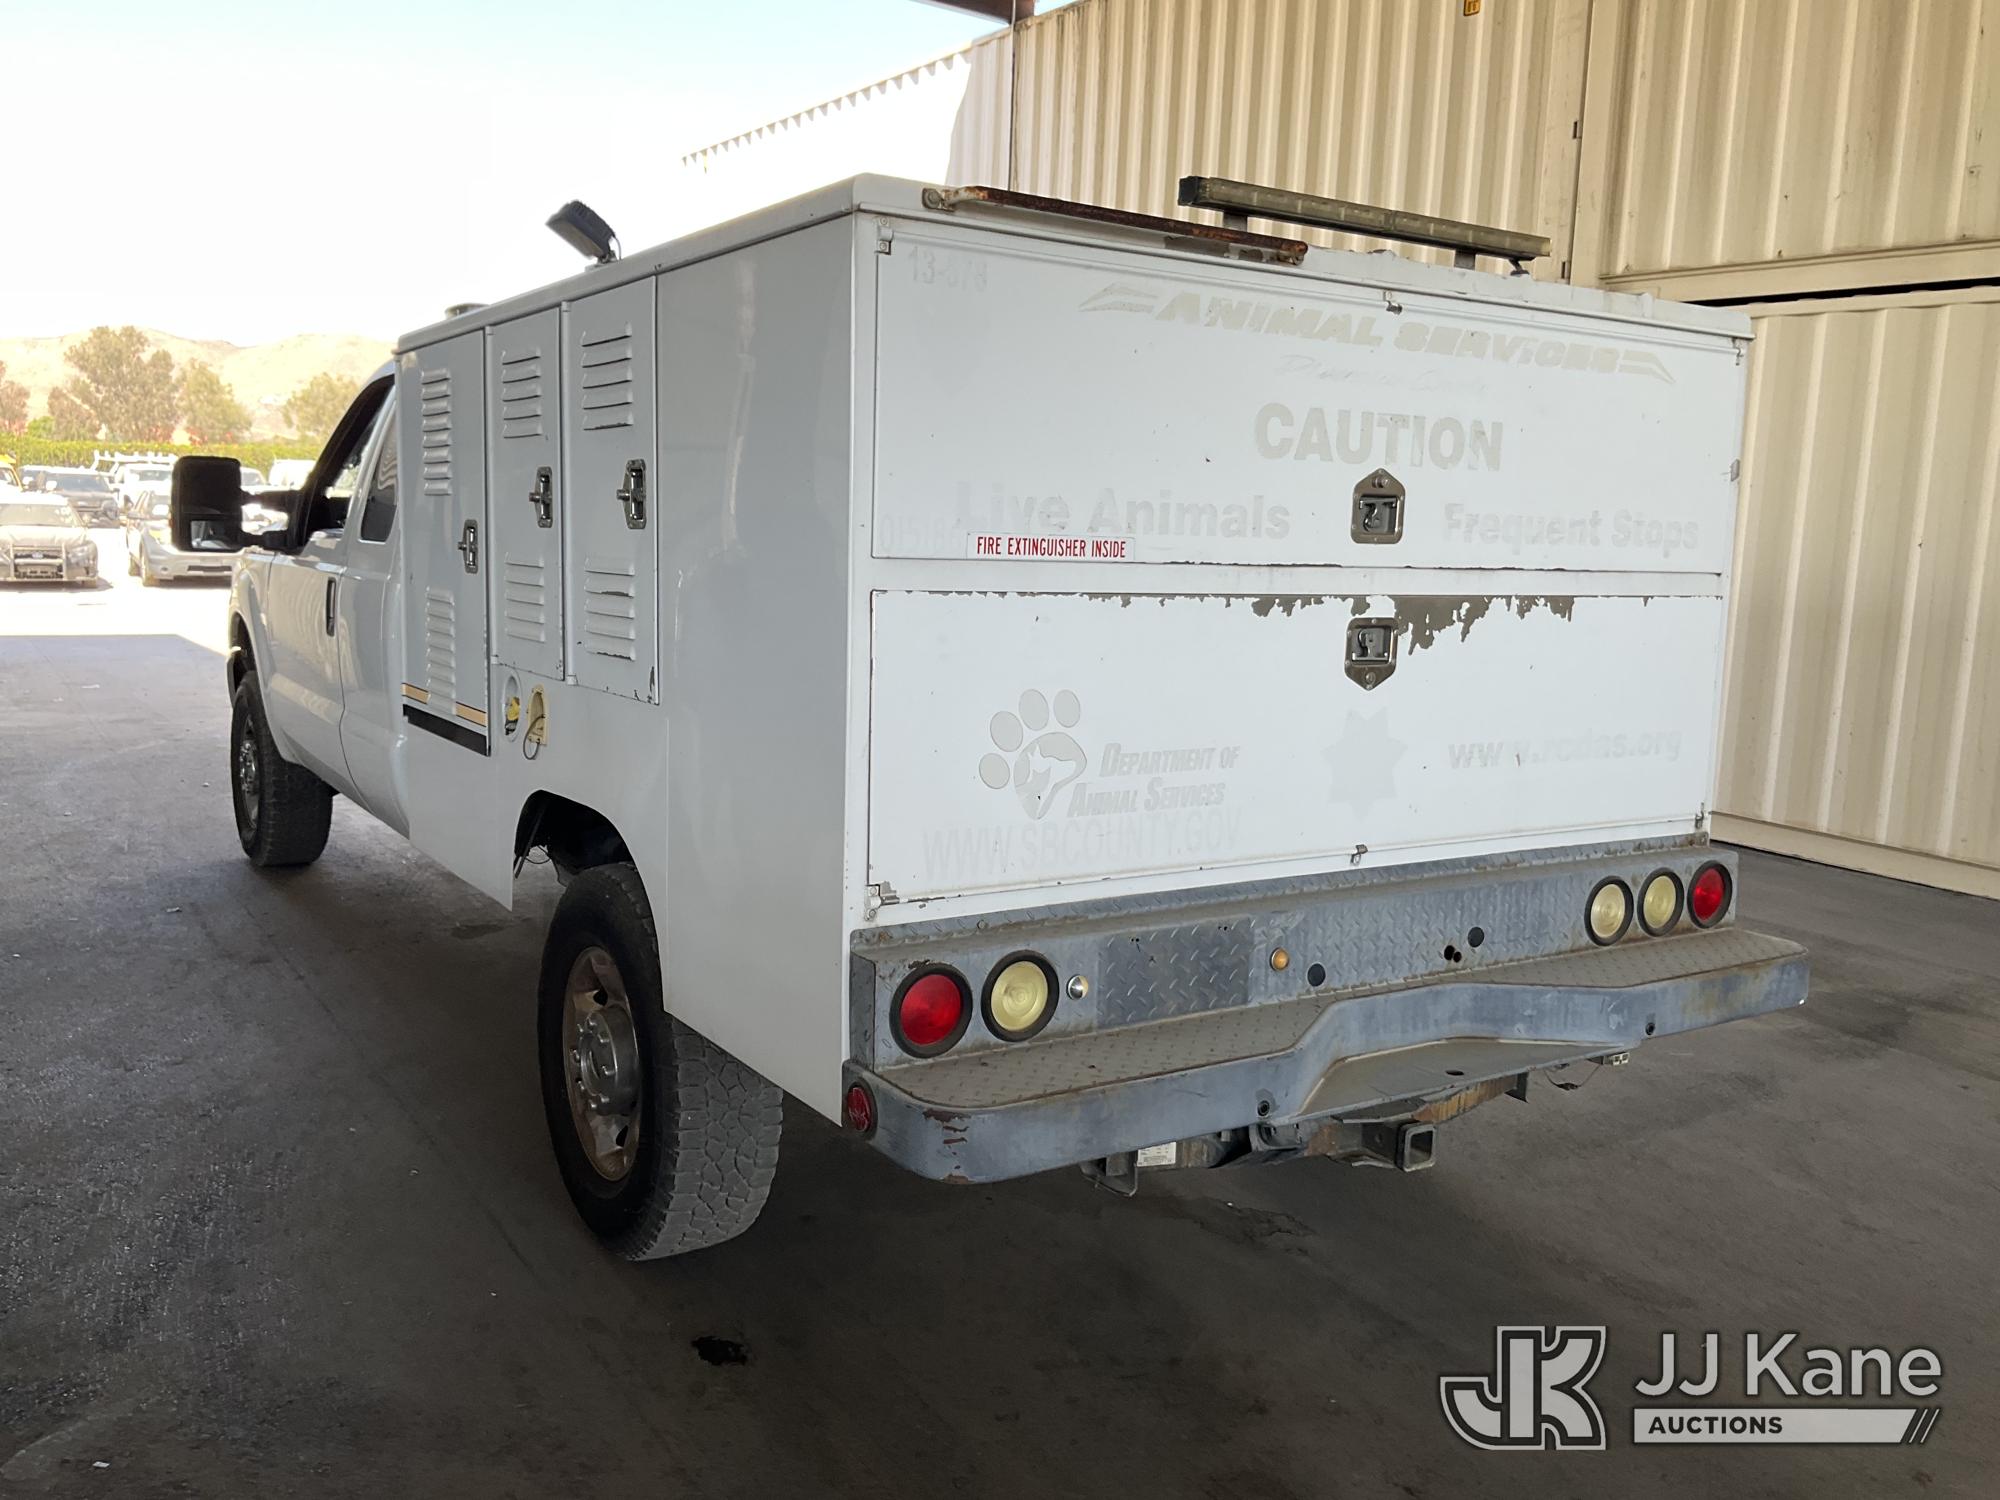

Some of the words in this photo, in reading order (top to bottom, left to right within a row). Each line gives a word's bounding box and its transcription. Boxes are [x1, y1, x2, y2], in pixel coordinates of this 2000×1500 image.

[1155, 294, 1384, 347] ANIMAL
[1394, 321, 1621, 374] SERVICES
[1255, 402, 1504, 472] CAUTION
[957, 480, 1070, 532] Live
[1087, 487, 1291, 540] Animals
[1443, 502, 1602, 556] Frequent
[1611, 509, 1700, 558] Stops
[977, 536, 1002, 555] FIRE
[1007, 537, 1087, 557] EXTINGUISHER
[1091, 540, 1126, 558] INSIDE
[1099, 742, 1217, 778] DEPARTMENT
[1219, 746, 1241, 769] OF
[1066, 782, 1139, 818] ANIMAL
[1143, 776, 1226, 811] SERVICES
